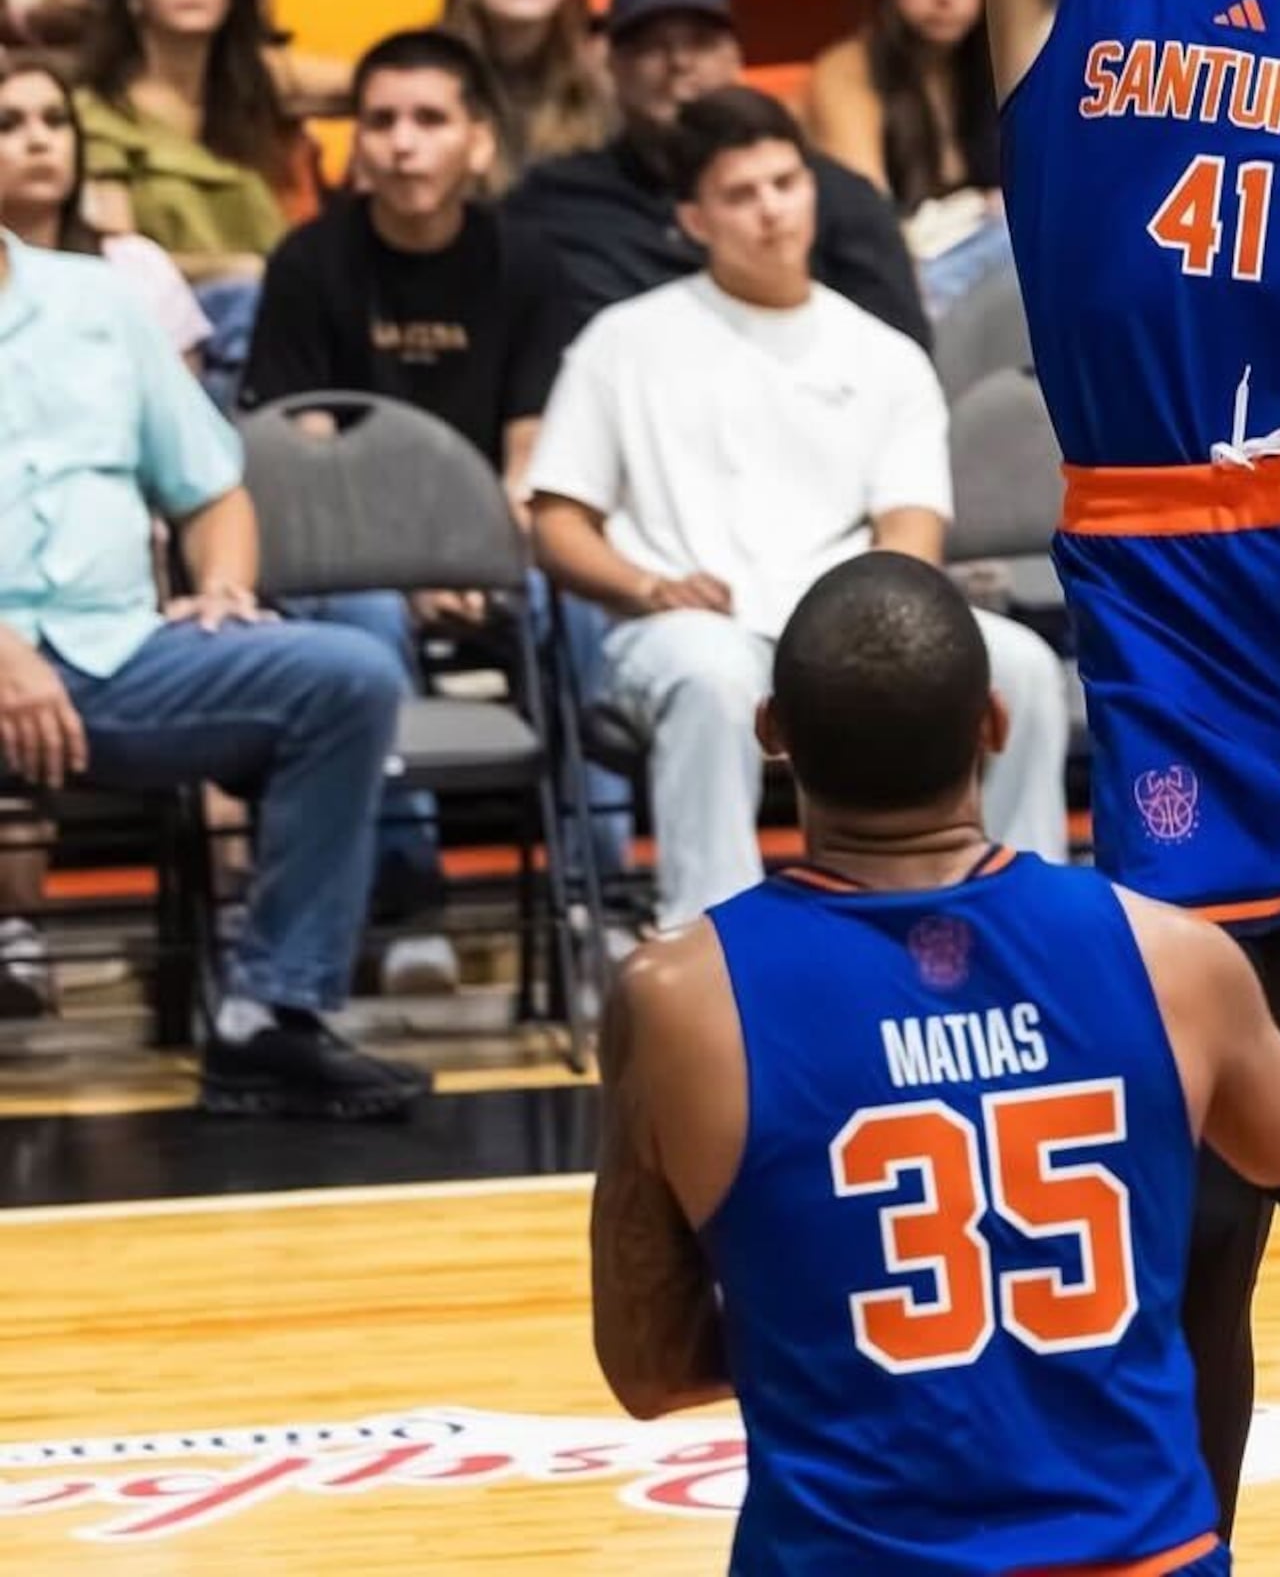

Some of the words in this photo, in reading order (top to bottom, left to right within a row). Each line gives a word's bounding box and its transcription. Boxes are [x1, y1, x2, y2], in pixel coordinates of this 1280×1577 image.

[1146, 154, 1274, 282] 41
[880, 1002, 1048, 1088] MATIAS
[829, 1076, 1140, 1375] 35
